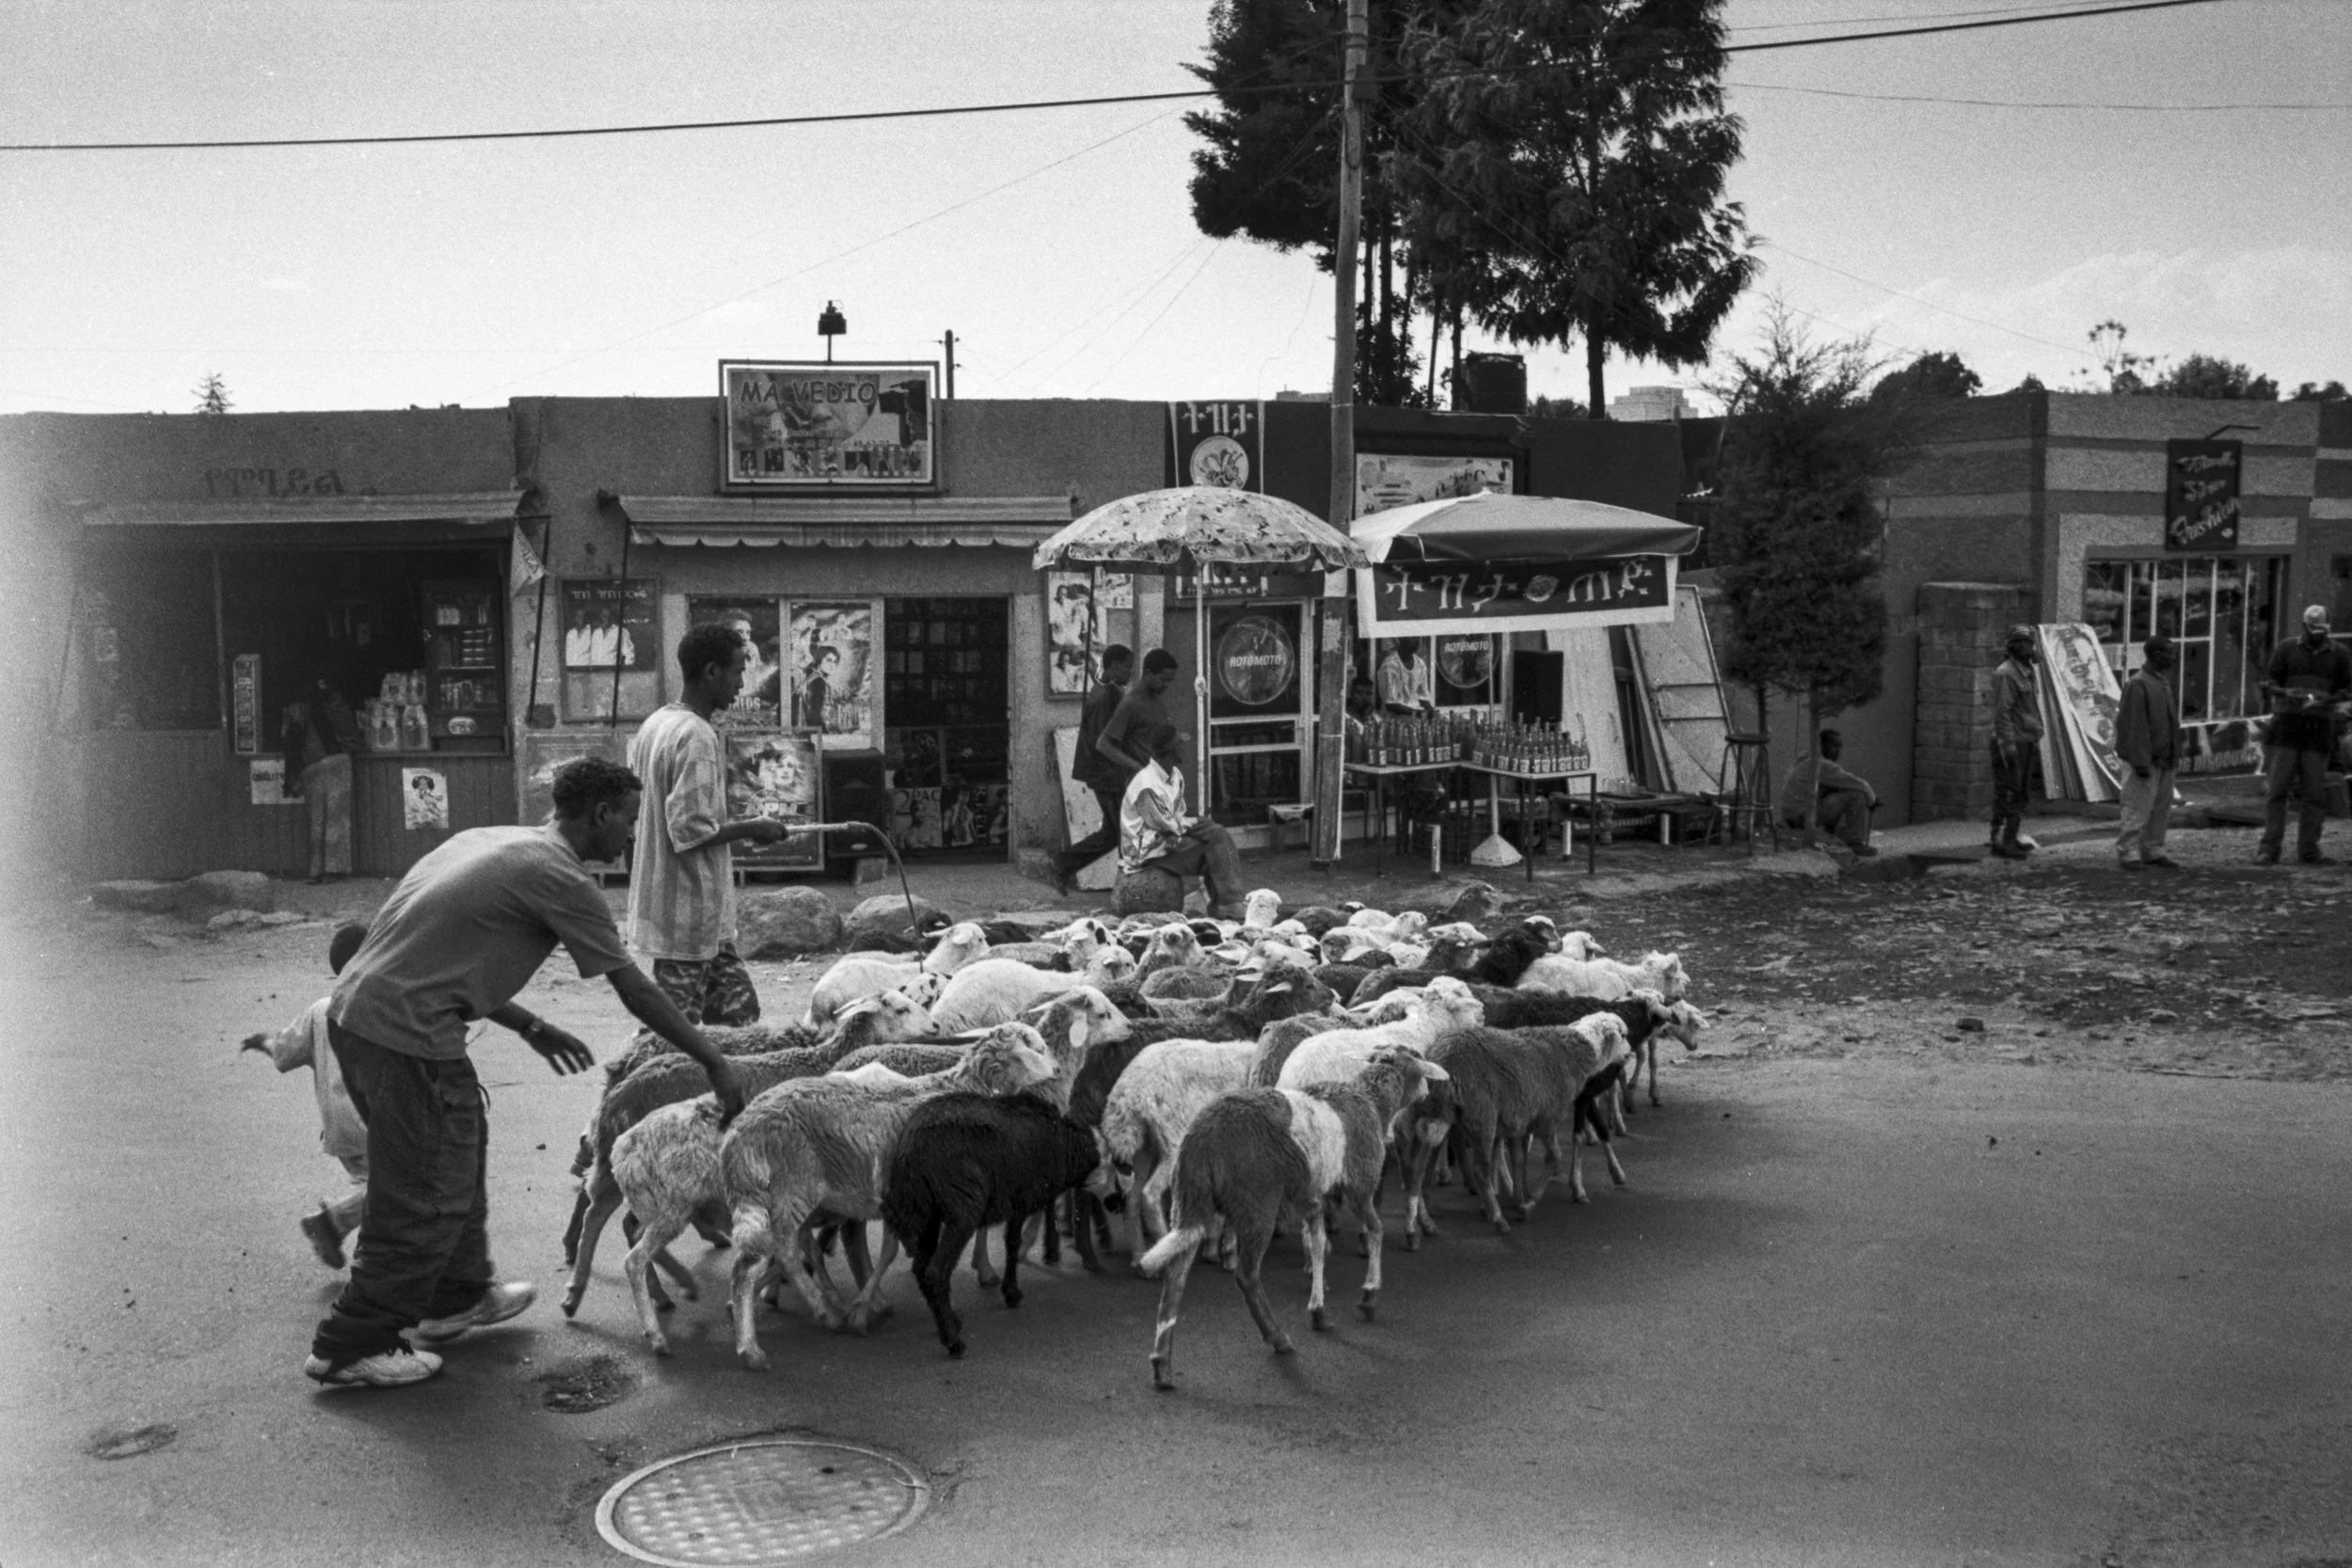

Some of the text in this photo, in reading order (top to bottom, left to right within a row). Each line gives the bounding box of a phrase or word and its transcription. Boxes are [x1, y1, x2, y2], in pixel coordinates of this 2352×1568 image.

[740, 380, 877, 404] MA VEDIO
[1181, 402, 1255, 436] ትዝታ
[1385, 564, 1518, 612] ትዝታ
